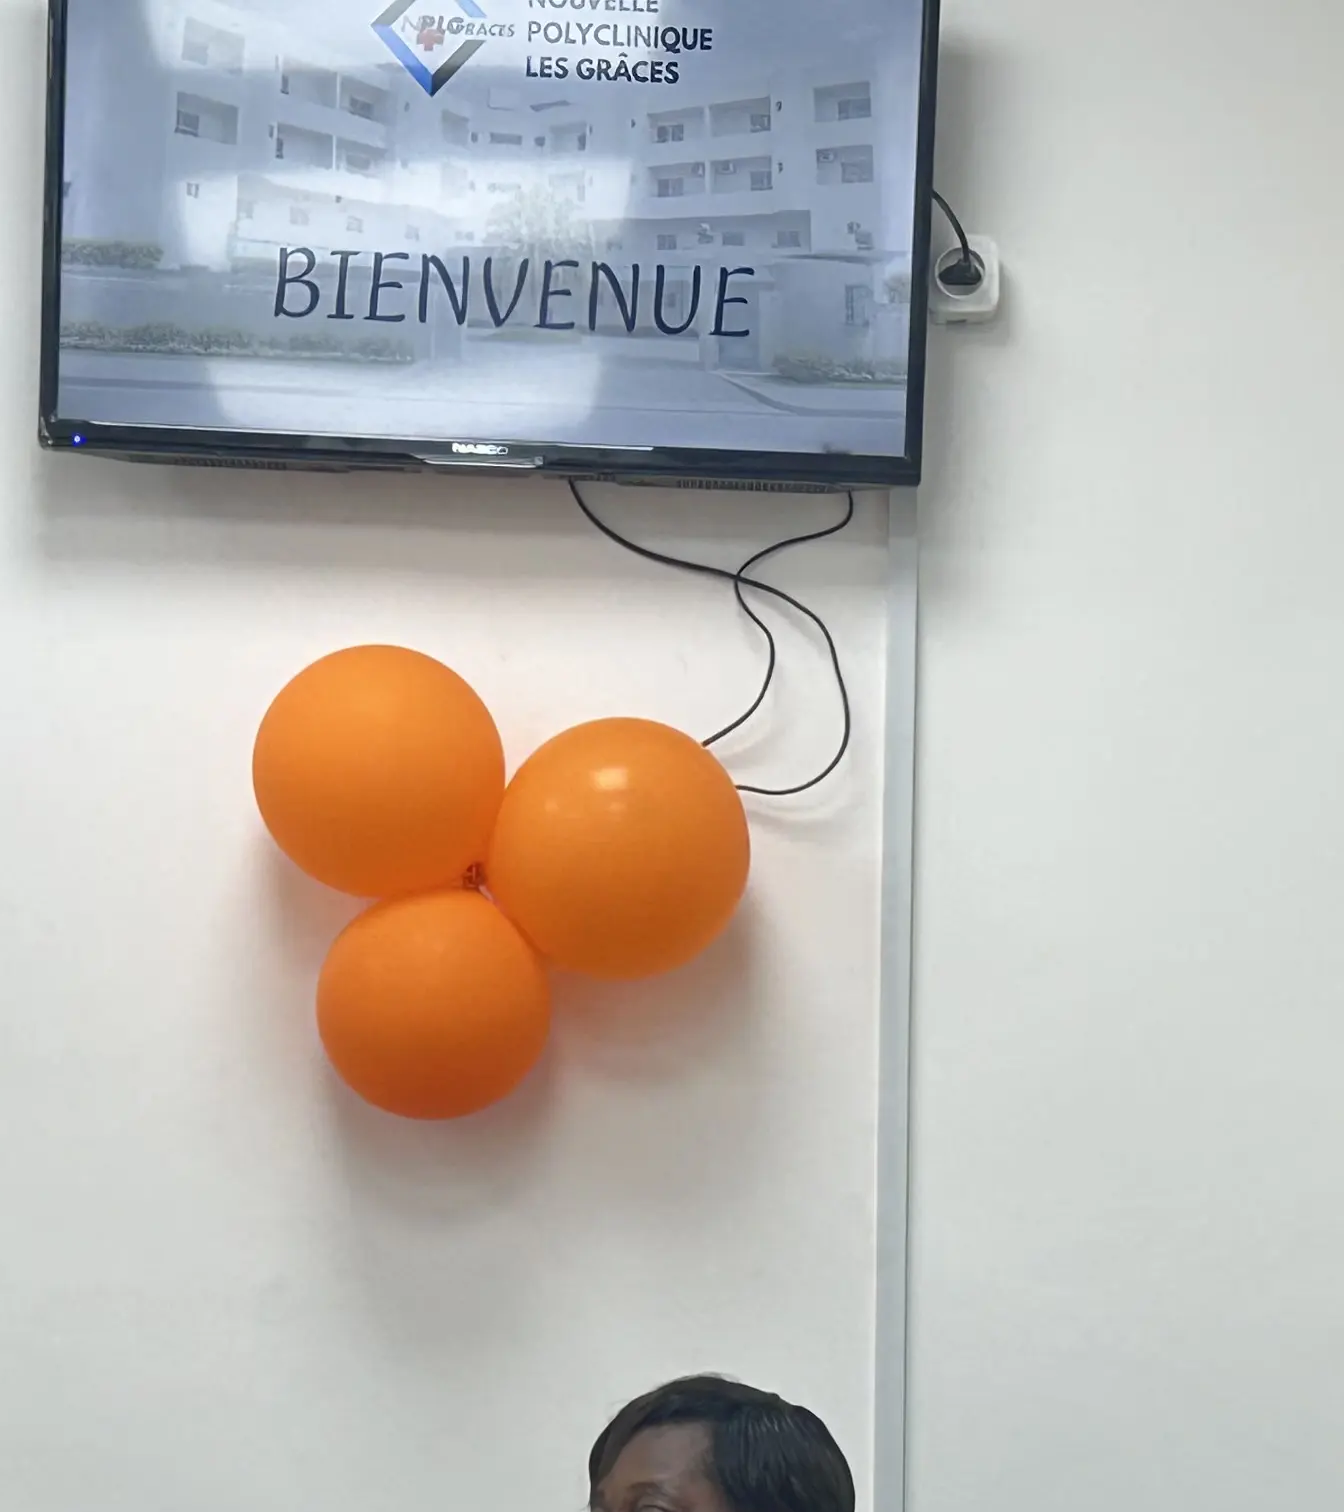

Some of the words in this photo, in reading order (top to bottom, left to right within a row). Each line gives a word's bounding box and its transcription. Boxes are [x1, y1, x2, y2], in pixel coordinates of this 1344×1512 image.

[527, 20, 713, 54] POLYCLINIQUE
[525, 55, 570, 79] LES
[576, 52, 680, 84] GRÂCES
[273, 246, 756, 338] BIENVENUE
